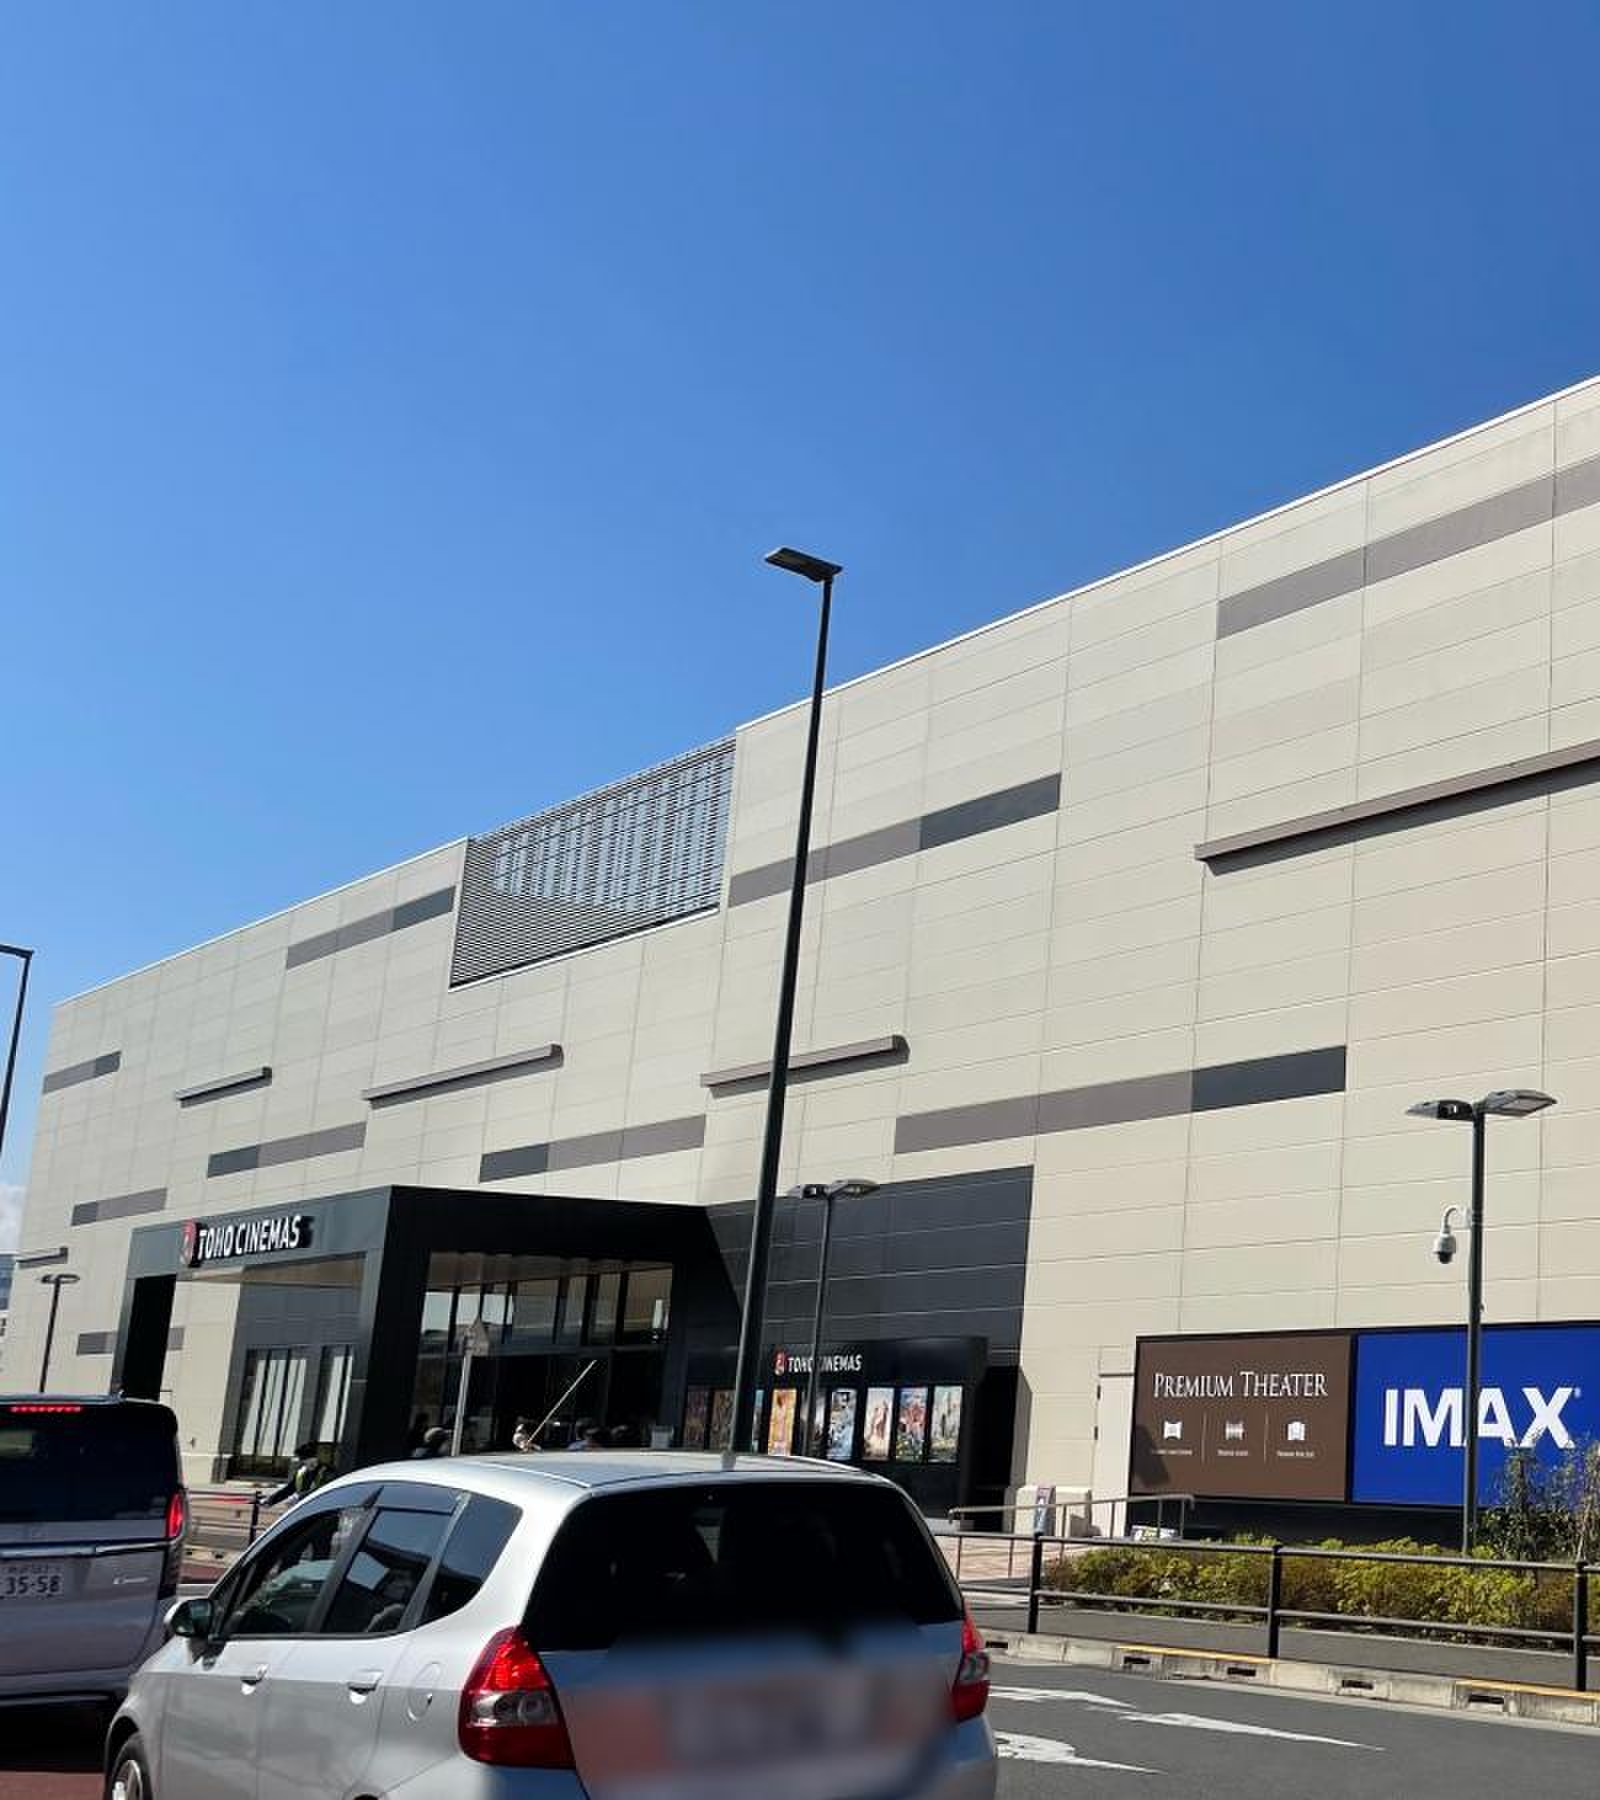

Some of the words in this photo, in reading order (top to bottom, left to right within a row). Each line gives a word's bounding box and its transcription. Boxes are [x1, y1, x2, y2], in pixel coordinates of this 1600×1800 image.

[197, 1225, 235, 1260] TOHO
[235, 1213, 302, 1255] CINEMAS
[1153, 1372, 1233, 1398] PREMIUM
[1239, 1371, 1329, 1397] THEATER
